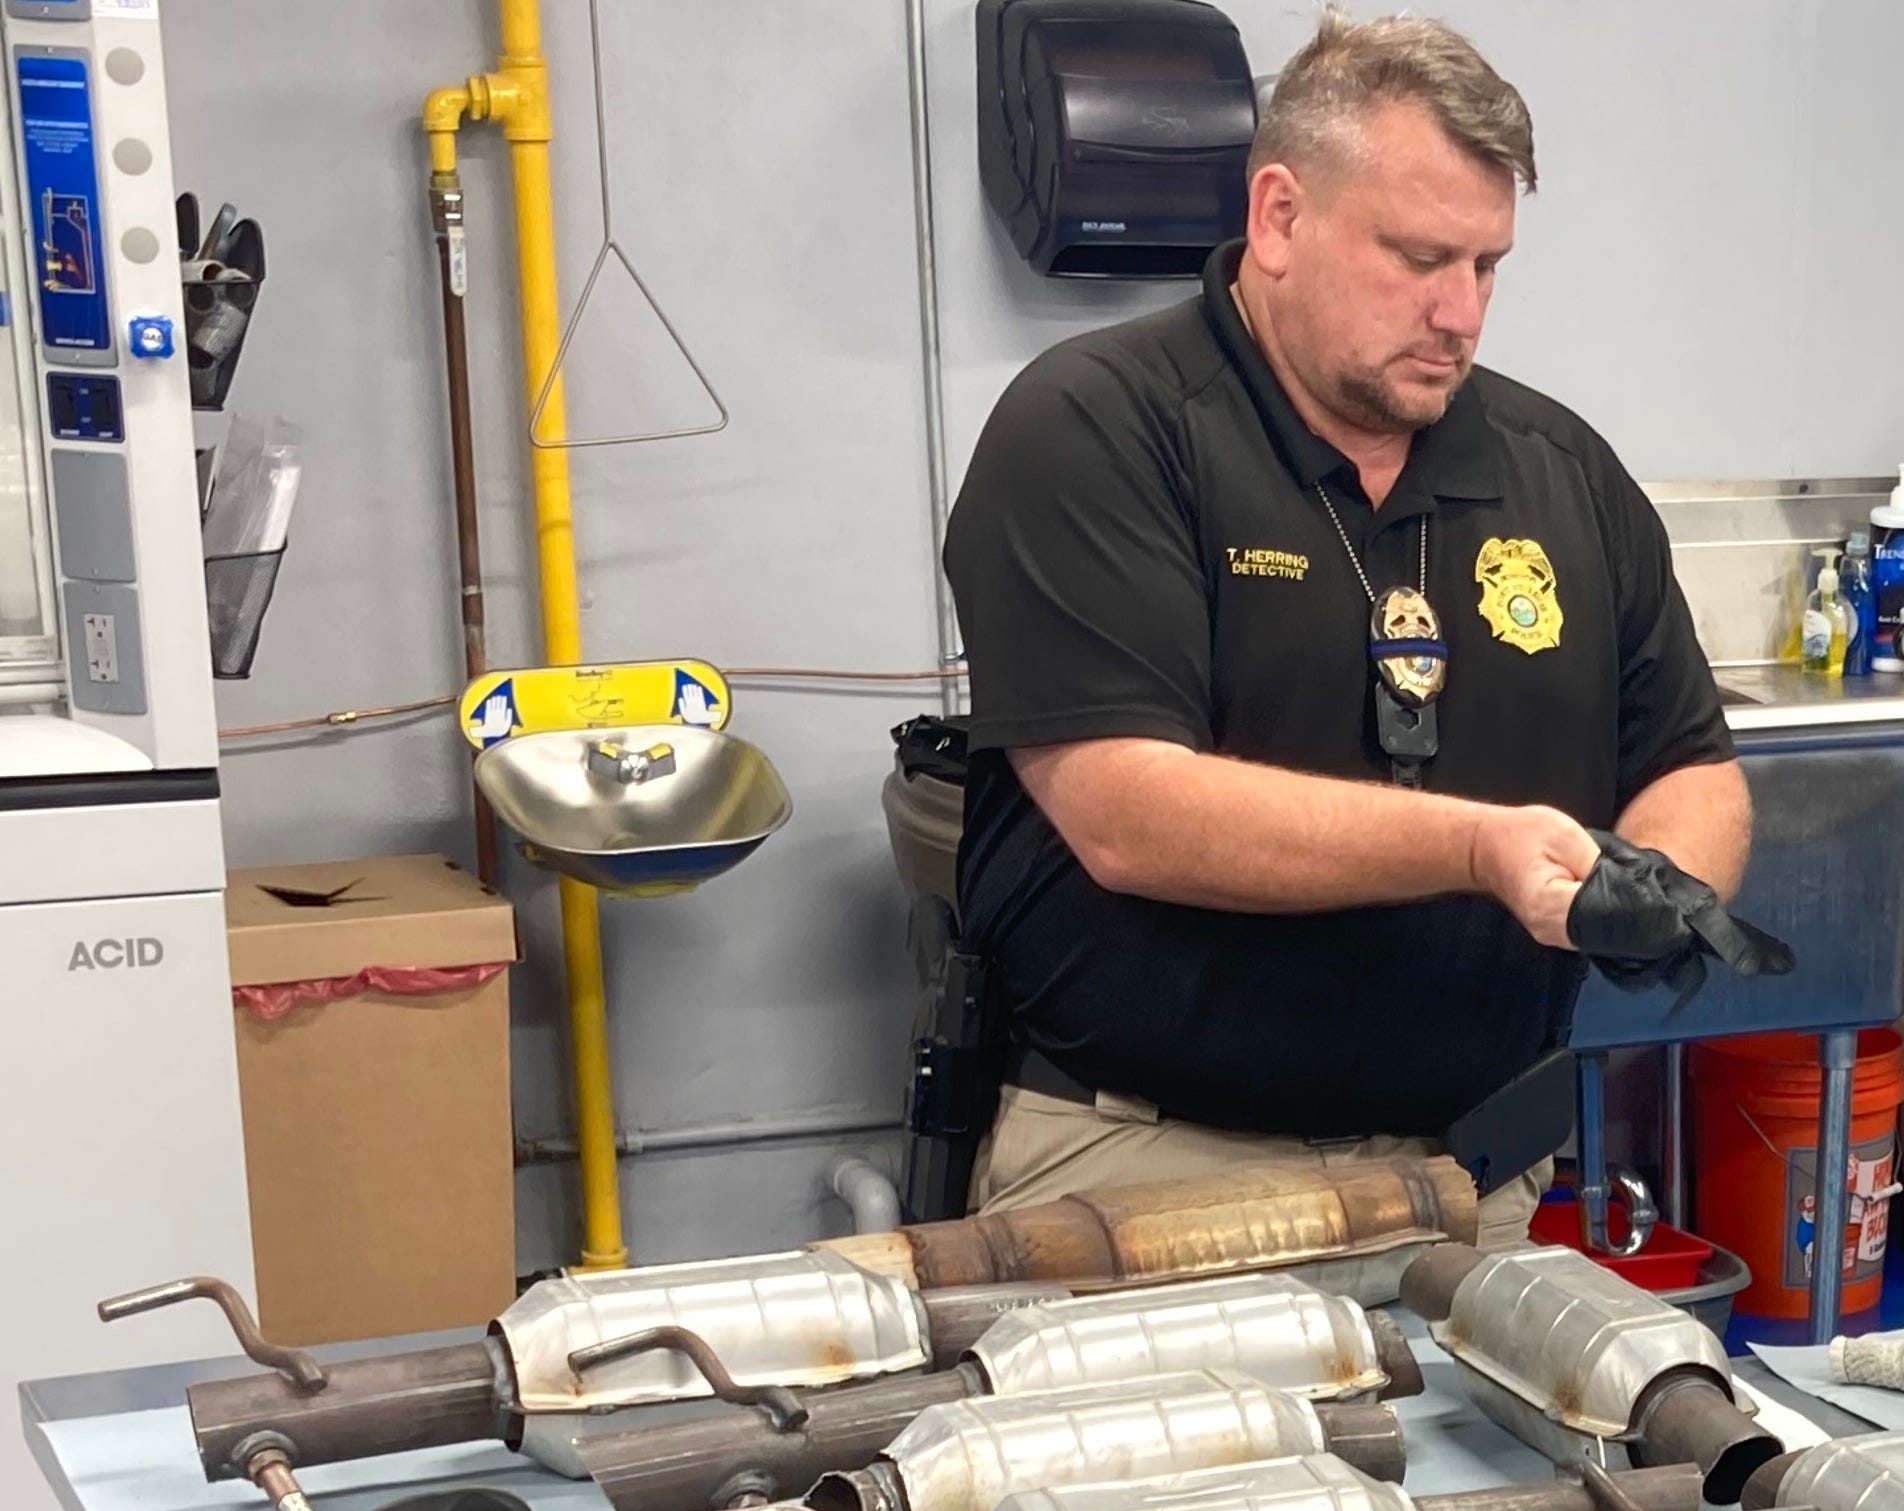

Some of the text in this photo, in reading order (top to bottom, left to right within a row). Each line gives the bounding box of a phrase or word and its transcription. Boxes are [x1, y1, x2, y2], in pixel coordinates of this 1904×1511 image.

[1245, 548, 1309, 570] HERRING
[1232, 561, 1305, 581] DETECTIVE
[67, 937, 164, 971] ACID
